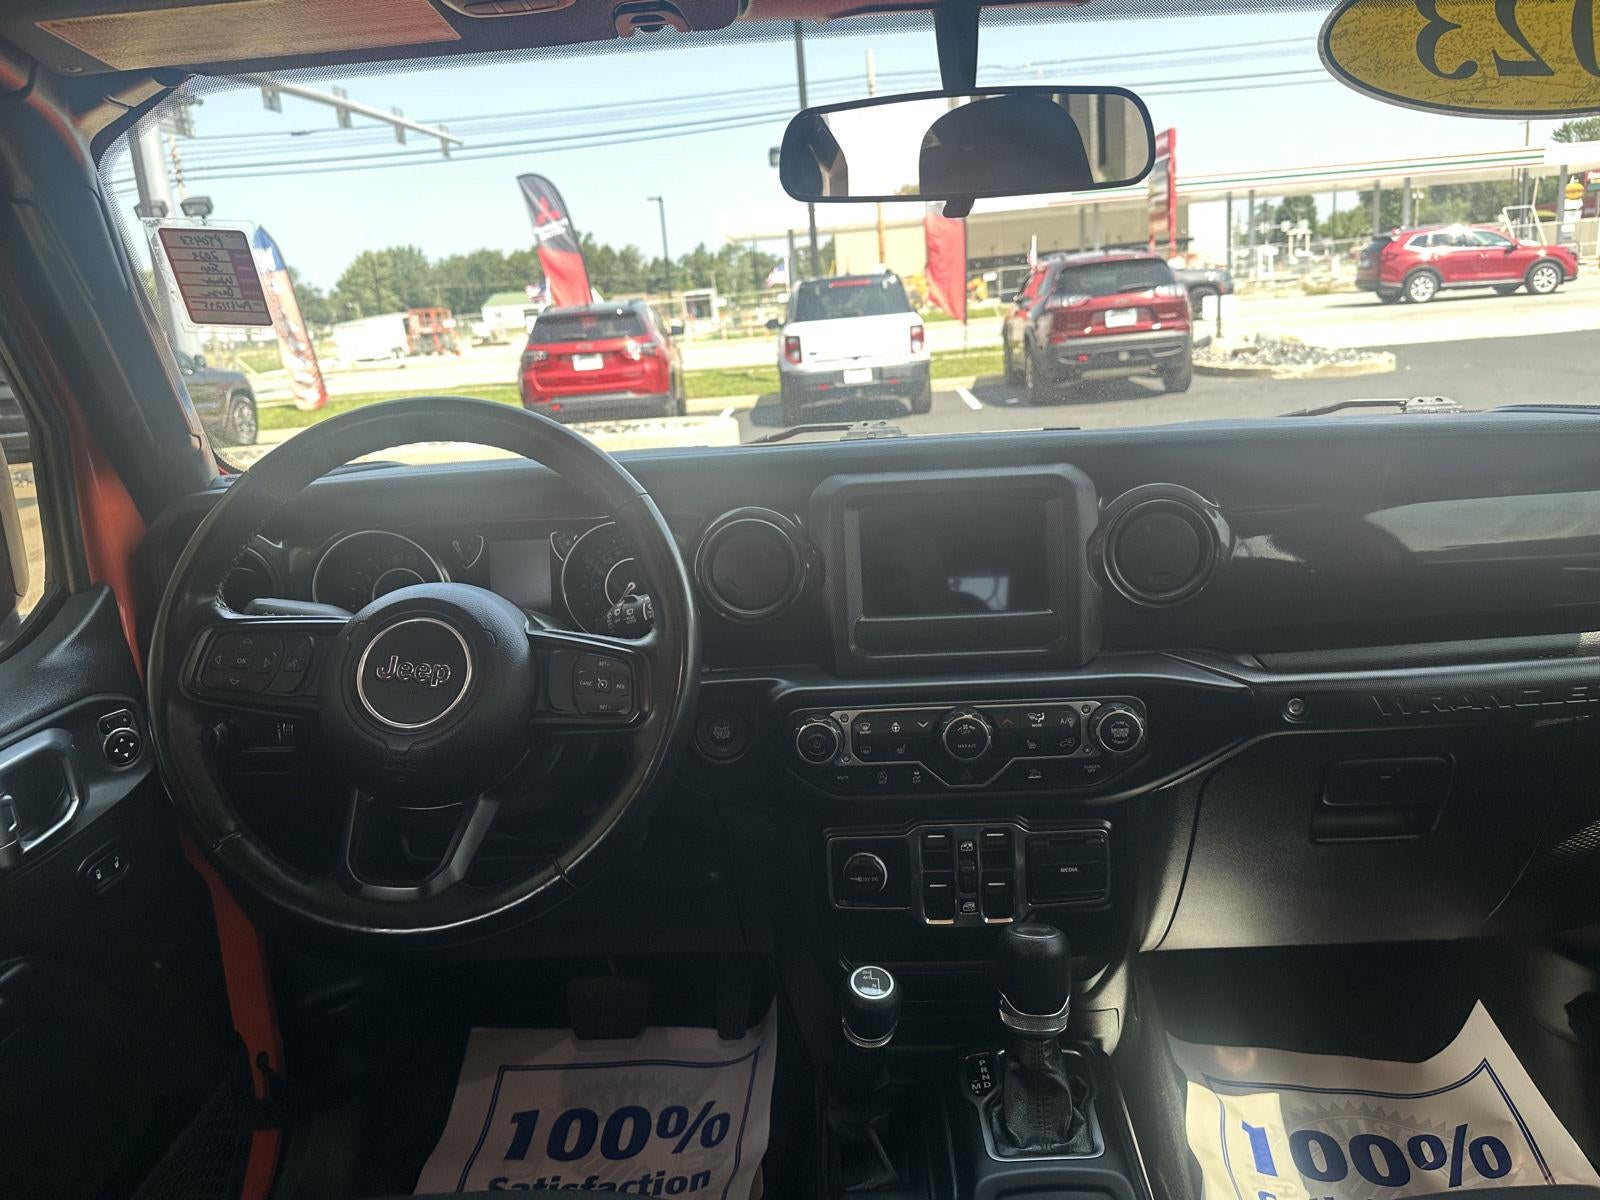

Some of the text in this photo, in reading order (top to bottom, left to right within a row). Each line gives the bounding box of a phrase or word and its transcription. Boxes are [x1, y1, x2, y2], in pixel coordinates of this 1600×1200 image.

[375, 654, 452, 688] Jeep
[978, 1059, 986, 1067] P
[981, 1073, 990, 1081] N
[971, 1082, 981, 1090] M
[983, 1081, 991, 1089] D
[503, 1099, 731, 1163] 100%
[1241, 1119, 1513, 1189] 100%
